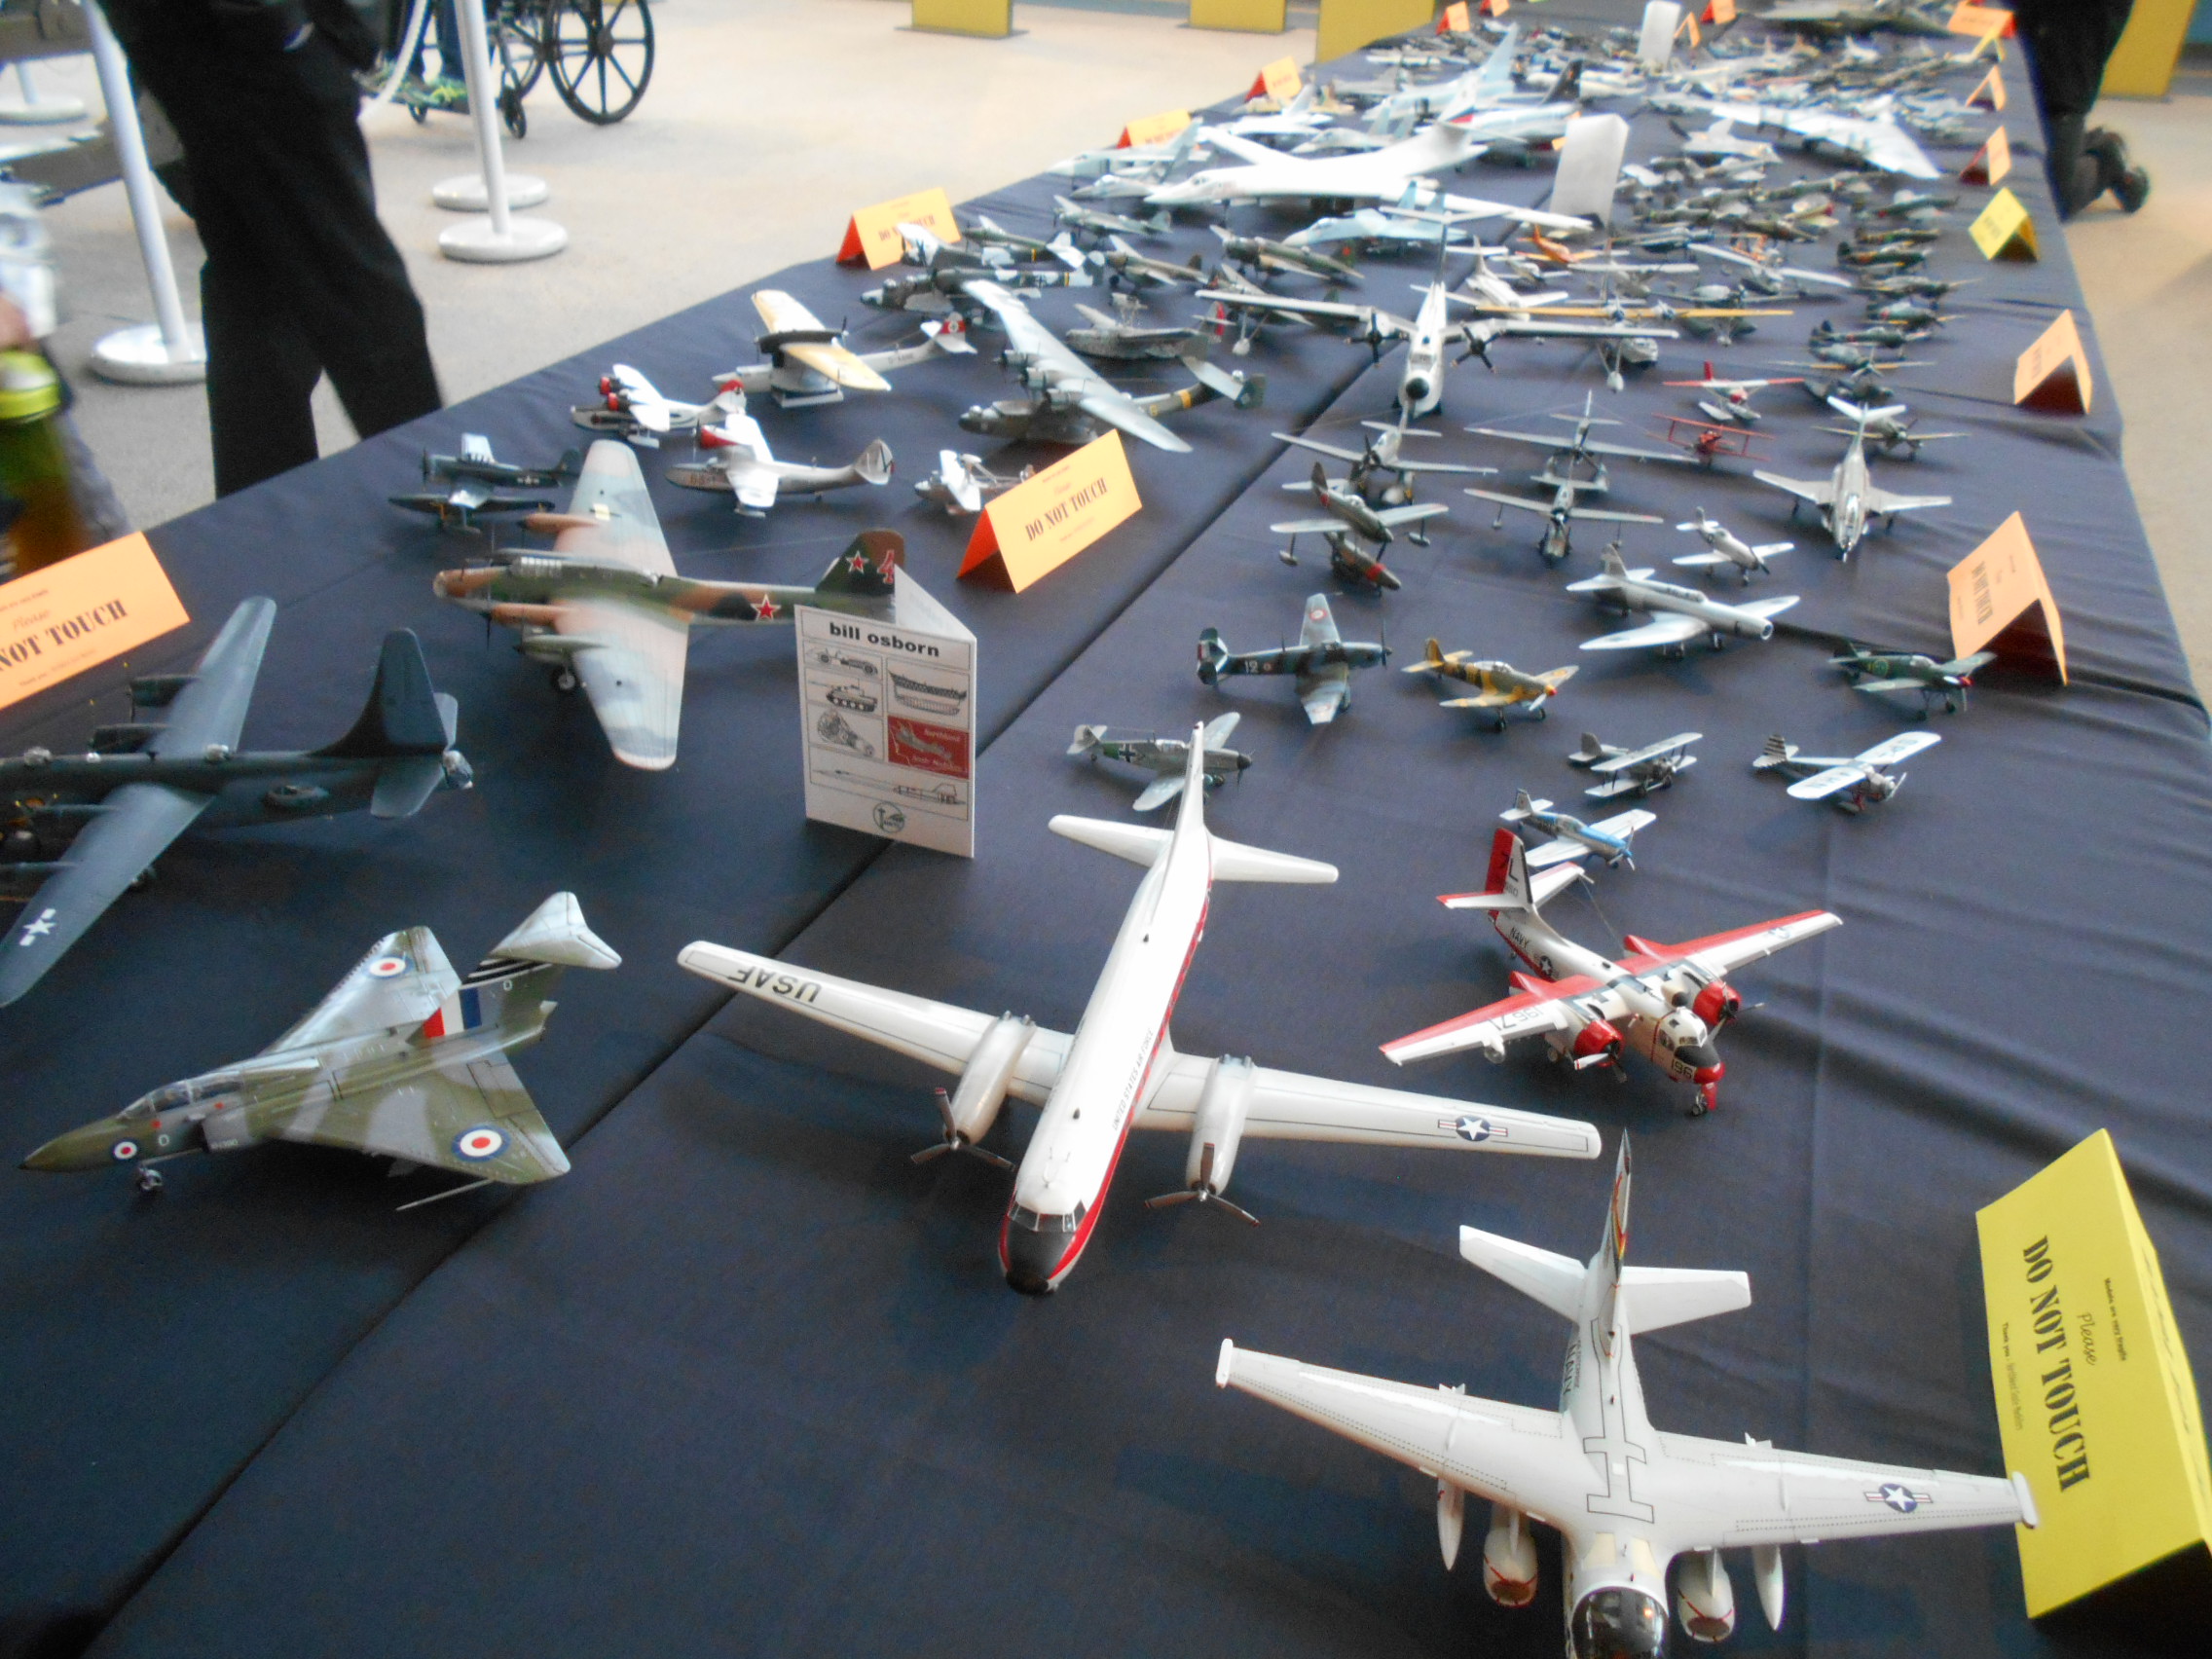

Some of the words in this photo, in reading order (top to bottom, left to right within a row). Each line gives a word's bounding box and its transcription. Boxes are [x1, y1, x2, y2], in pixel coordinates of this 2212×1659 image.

[1025, 518, 1045, 541] DO
[1044, 502, 1070, 530] NOT
[1070, 477, 1108, 513] TOUCH
[45, 597, 129, 646] TOUCH
[830, 622, 860, 641] bill
[867, 633, 940, 657] osborn
[1509, 926, 1530, 949] NAVY
[728, 966, 823, 1004] USAF
[2022, 1235, 2053, 1284] DO
[2030, 1284, 2067, 1354] NOT
[2077, 1311, 2098, 1367] Please
[2041, 1357, 2090, 1493] TOUCH
